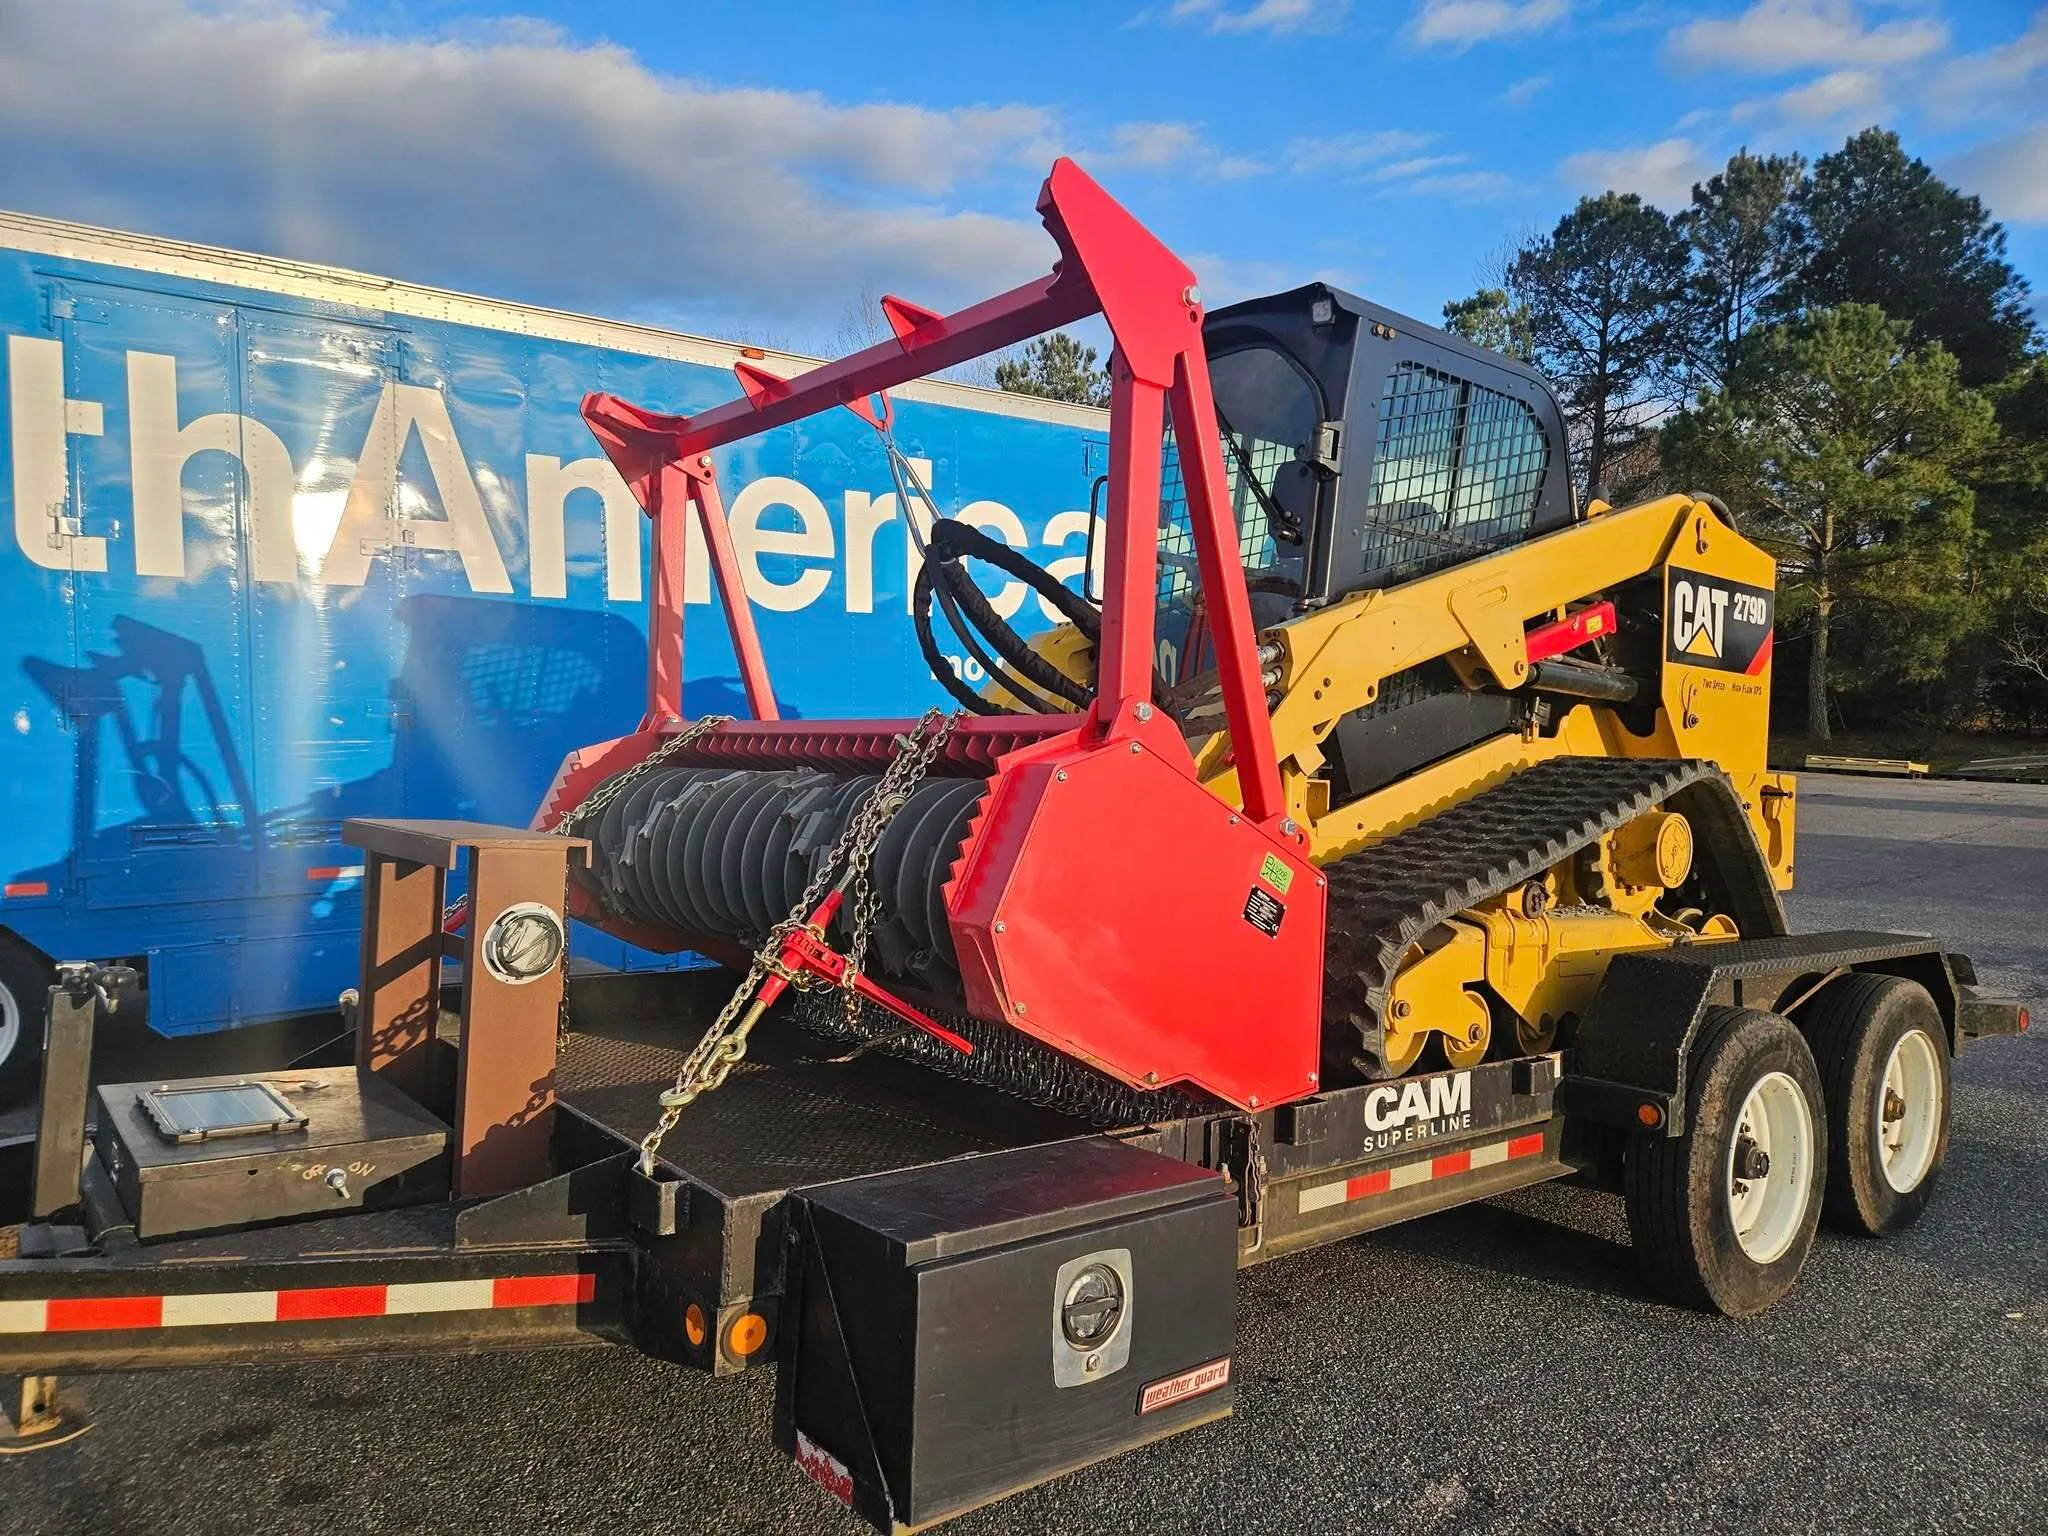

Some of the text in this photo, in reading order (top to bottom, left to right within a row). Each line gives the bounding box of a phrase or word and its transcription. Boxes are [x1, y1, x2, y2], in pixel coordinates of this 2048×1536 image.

[1674, 581, 1767, 658] CAT 279D
[1364, 1071, 1471, 1132] CAM
[1363, 1113, 1470, 1152] SUPERLINE
[348, 1161, 376, 1177] ON
[1146, 1362, 1226, 1405] weather guard
